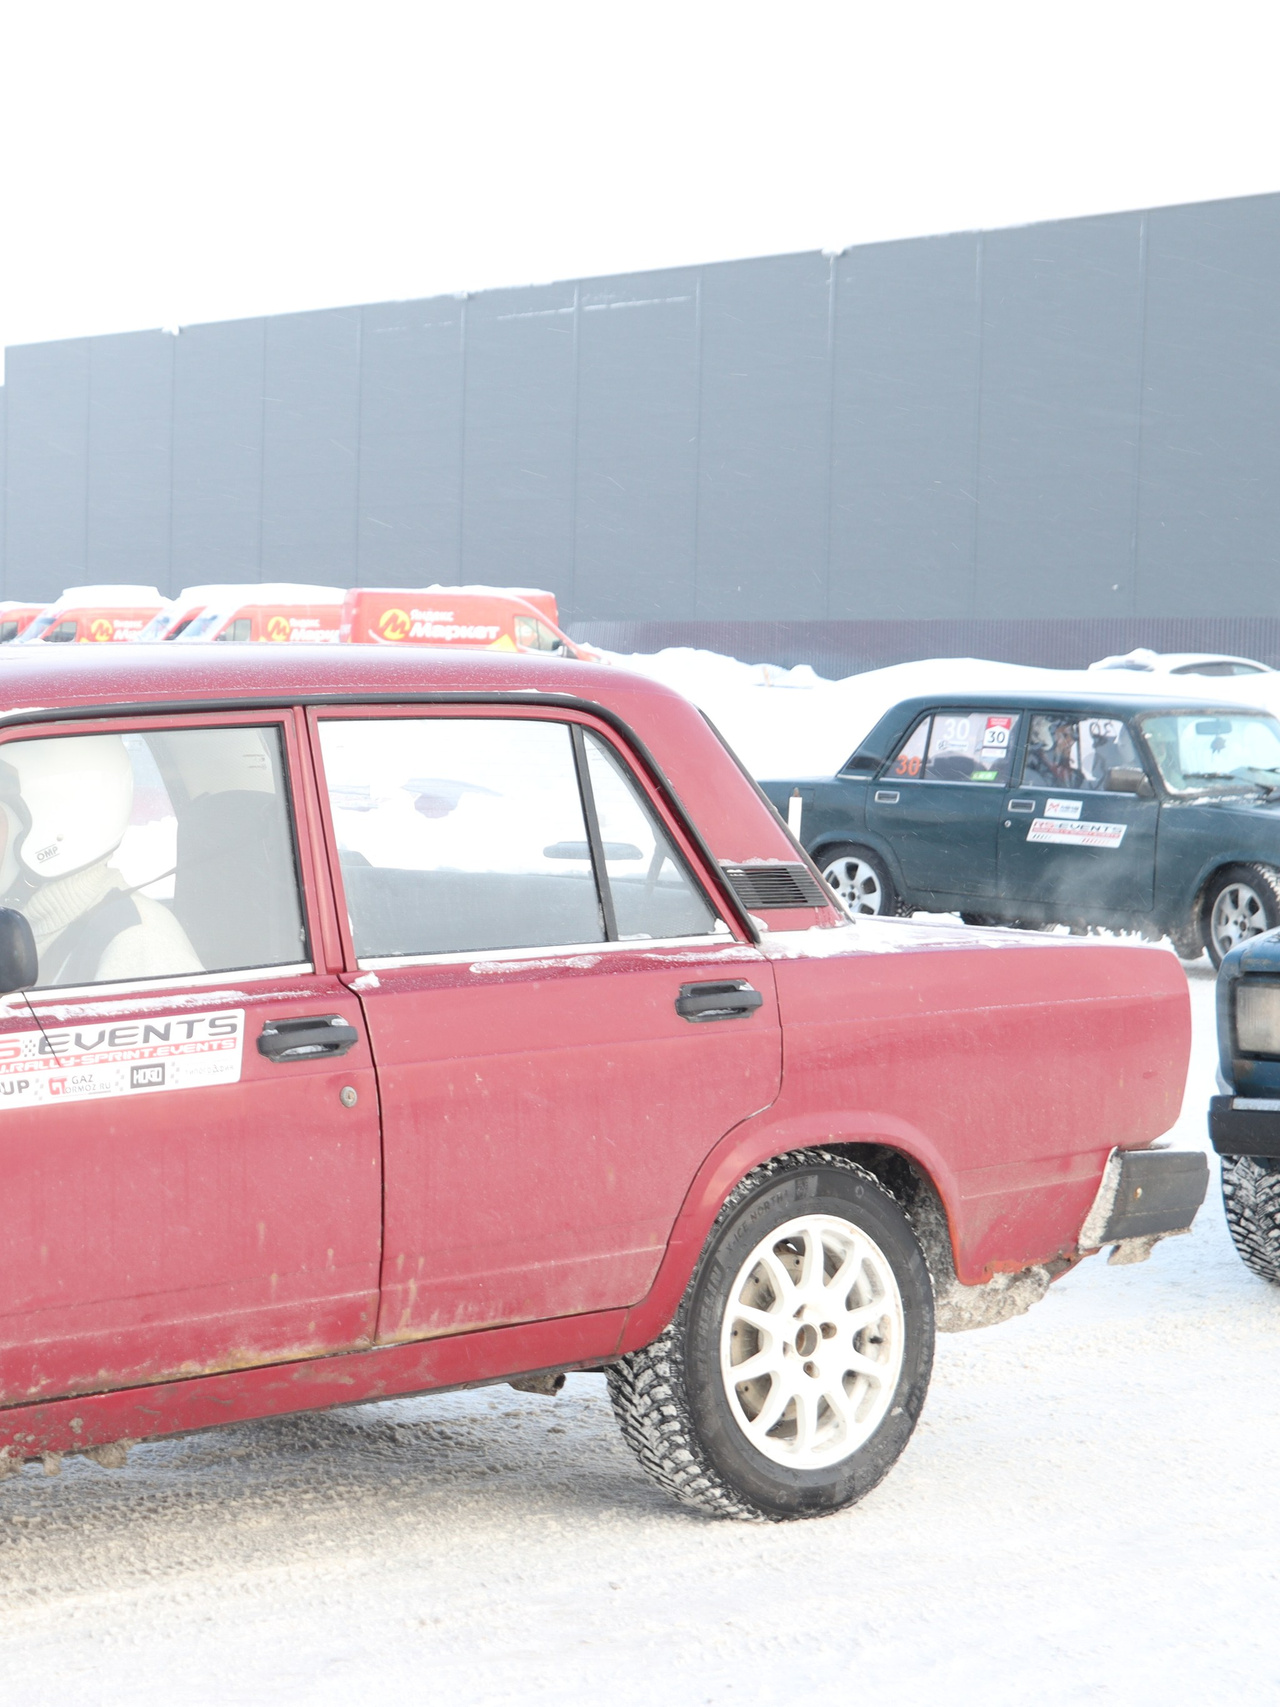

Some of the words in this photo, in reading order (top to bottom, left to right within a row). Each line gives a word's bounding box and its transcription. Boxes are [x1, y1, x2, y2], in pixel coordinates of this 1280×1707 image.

[409, 621, 501, 641] Маркет
[943, 718, 971, 741] 30
[987, 730, 1006, 744] 30
[895, 754, 921, 776] 30
[1058, 821, 1123, 833] EVENTS
[36, 845, 59, 862] OMP
[38, 1014, 238, 1056] EVENTS
[72, 1074, 94, 1085] GAZ
